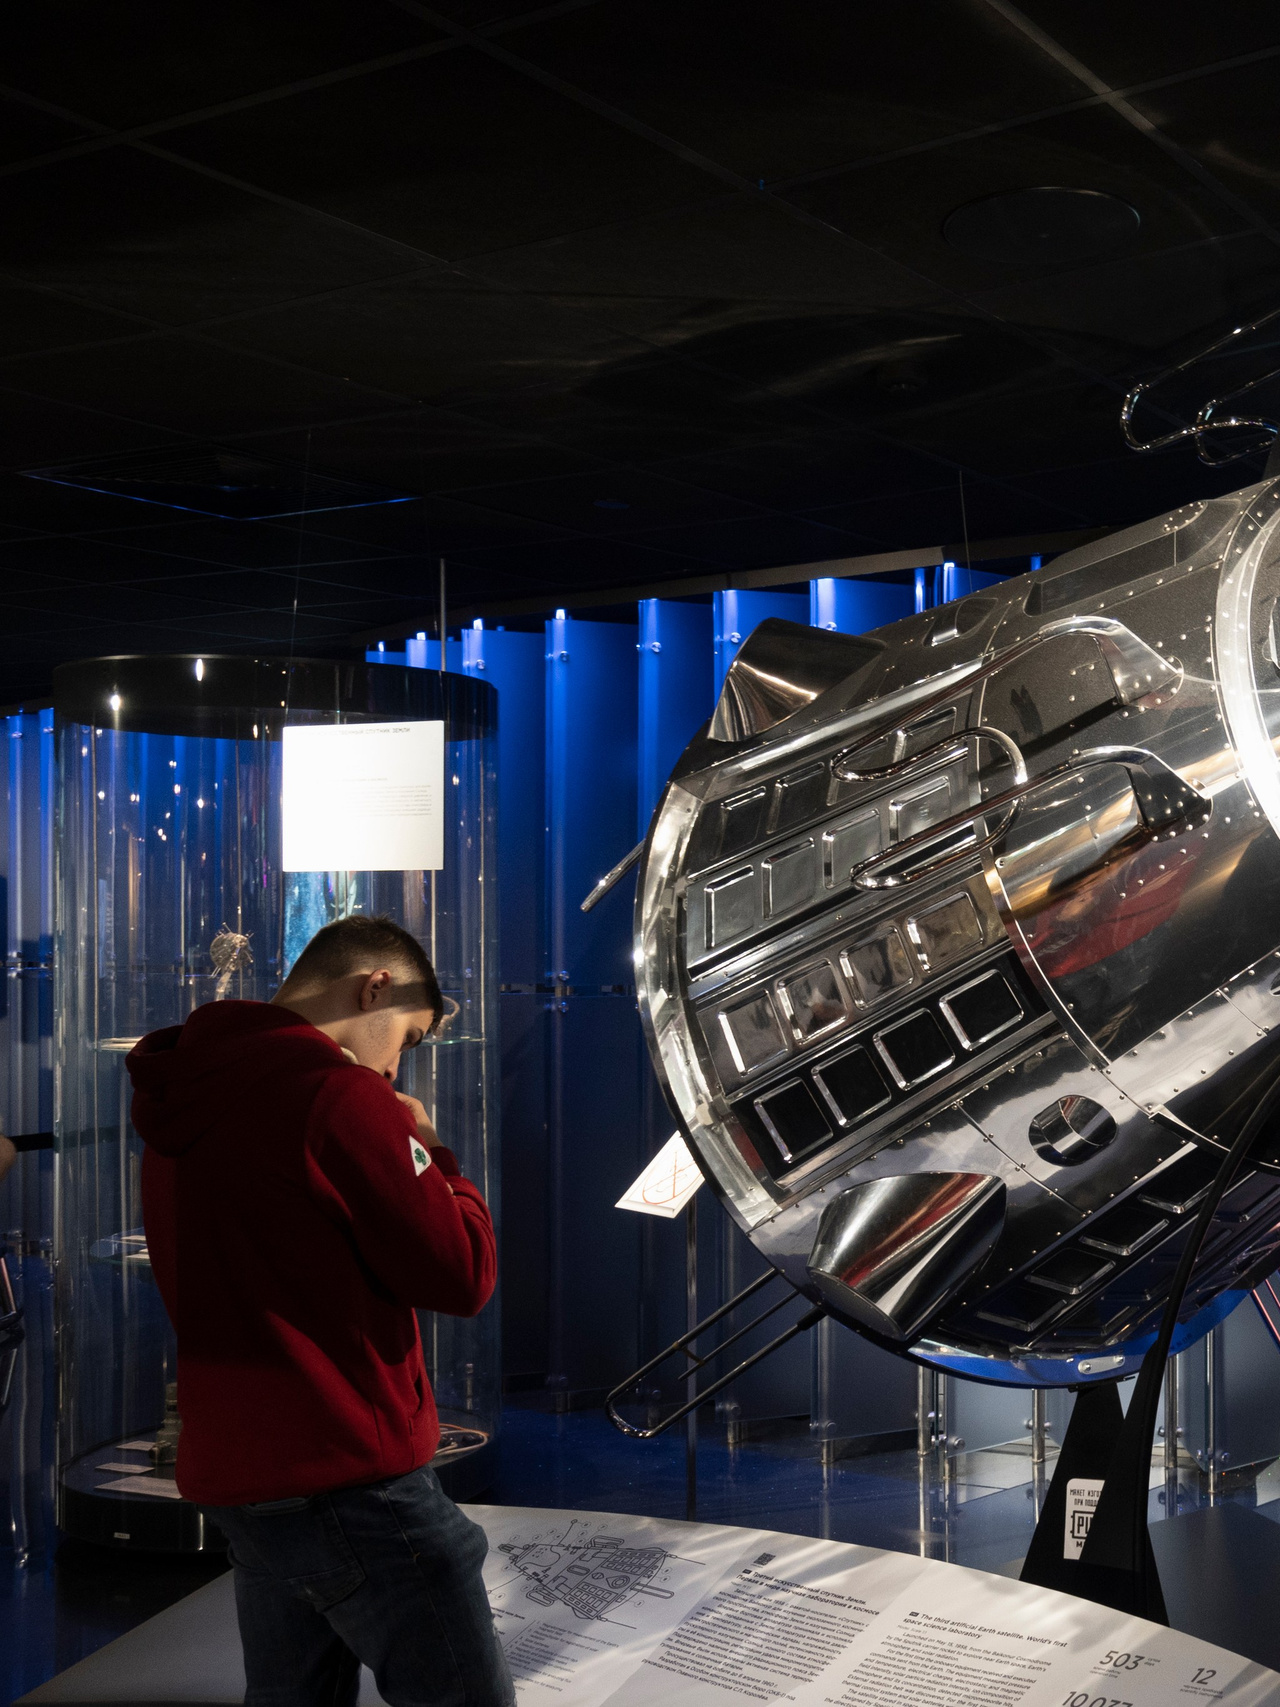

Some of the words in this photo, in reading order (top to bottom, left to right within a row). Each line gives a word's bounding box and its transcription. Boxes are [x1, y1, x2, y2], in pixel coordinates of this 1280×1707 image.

[753, 1572, 774, 1580] Третий
[820, 1591, 845, 1600] спутник
[737, 1575, 759, 1584] Первая
[781, 1588, 806, 1597] научная
[853, 1606, 880, 1615] космосе
[950, 1622, 978, 1630] artificial
[948, 1628, 982, 1639] laboratory
[881, 1642, 911, 1650] atmosphere
[903, 1633, 928, 1641] Launched
[1016, 1656, 1051, 1666] Cosmodrome
[870, 1653, 896, 1661] commands
[1099, 1650, 1145, 1670] 503
[853, 1669, 882, 1678] atmosphere
[1190, 1668, 1217, 1685] 12
